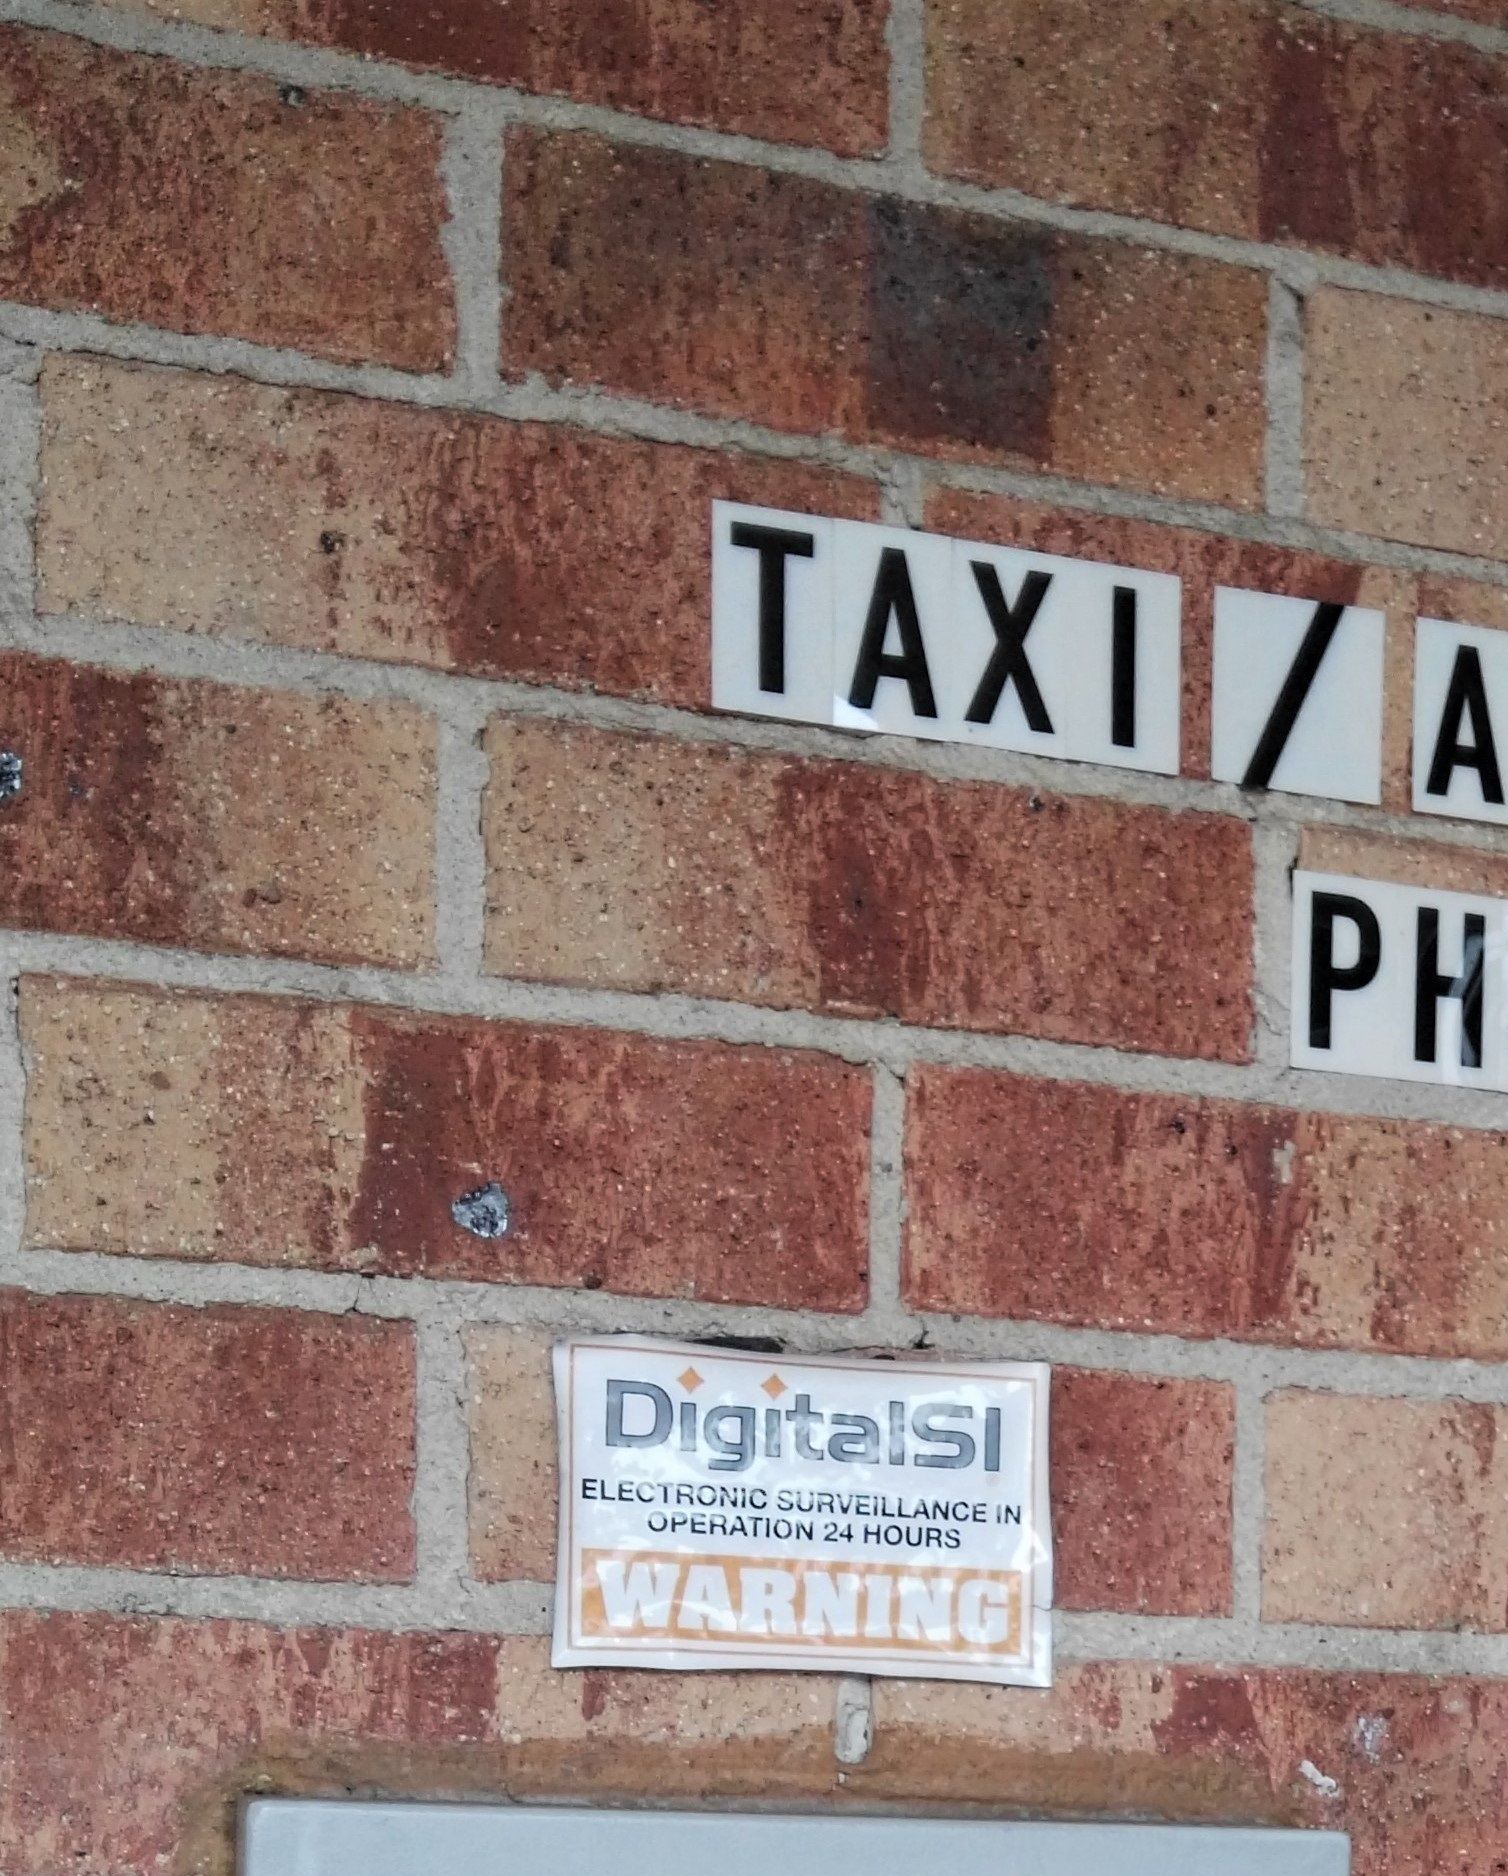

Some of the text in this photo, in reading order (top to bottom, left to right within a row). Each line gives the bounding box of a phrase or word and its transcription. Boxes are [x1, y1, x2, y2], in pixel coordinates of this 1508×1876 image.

[730, 520, 1137, 749] TAXI
[1238, 602, 1346, 790] /
[605, 1365, 1001, 1473] DigitalSI
[582, 1478, 1023, 1525] ELECTRONIC SURVEILLANCE IN
[648, 1510, 961, 1549] OPERATION 24 HOURS
[595, 1557, 1009, 1645] WARNING
